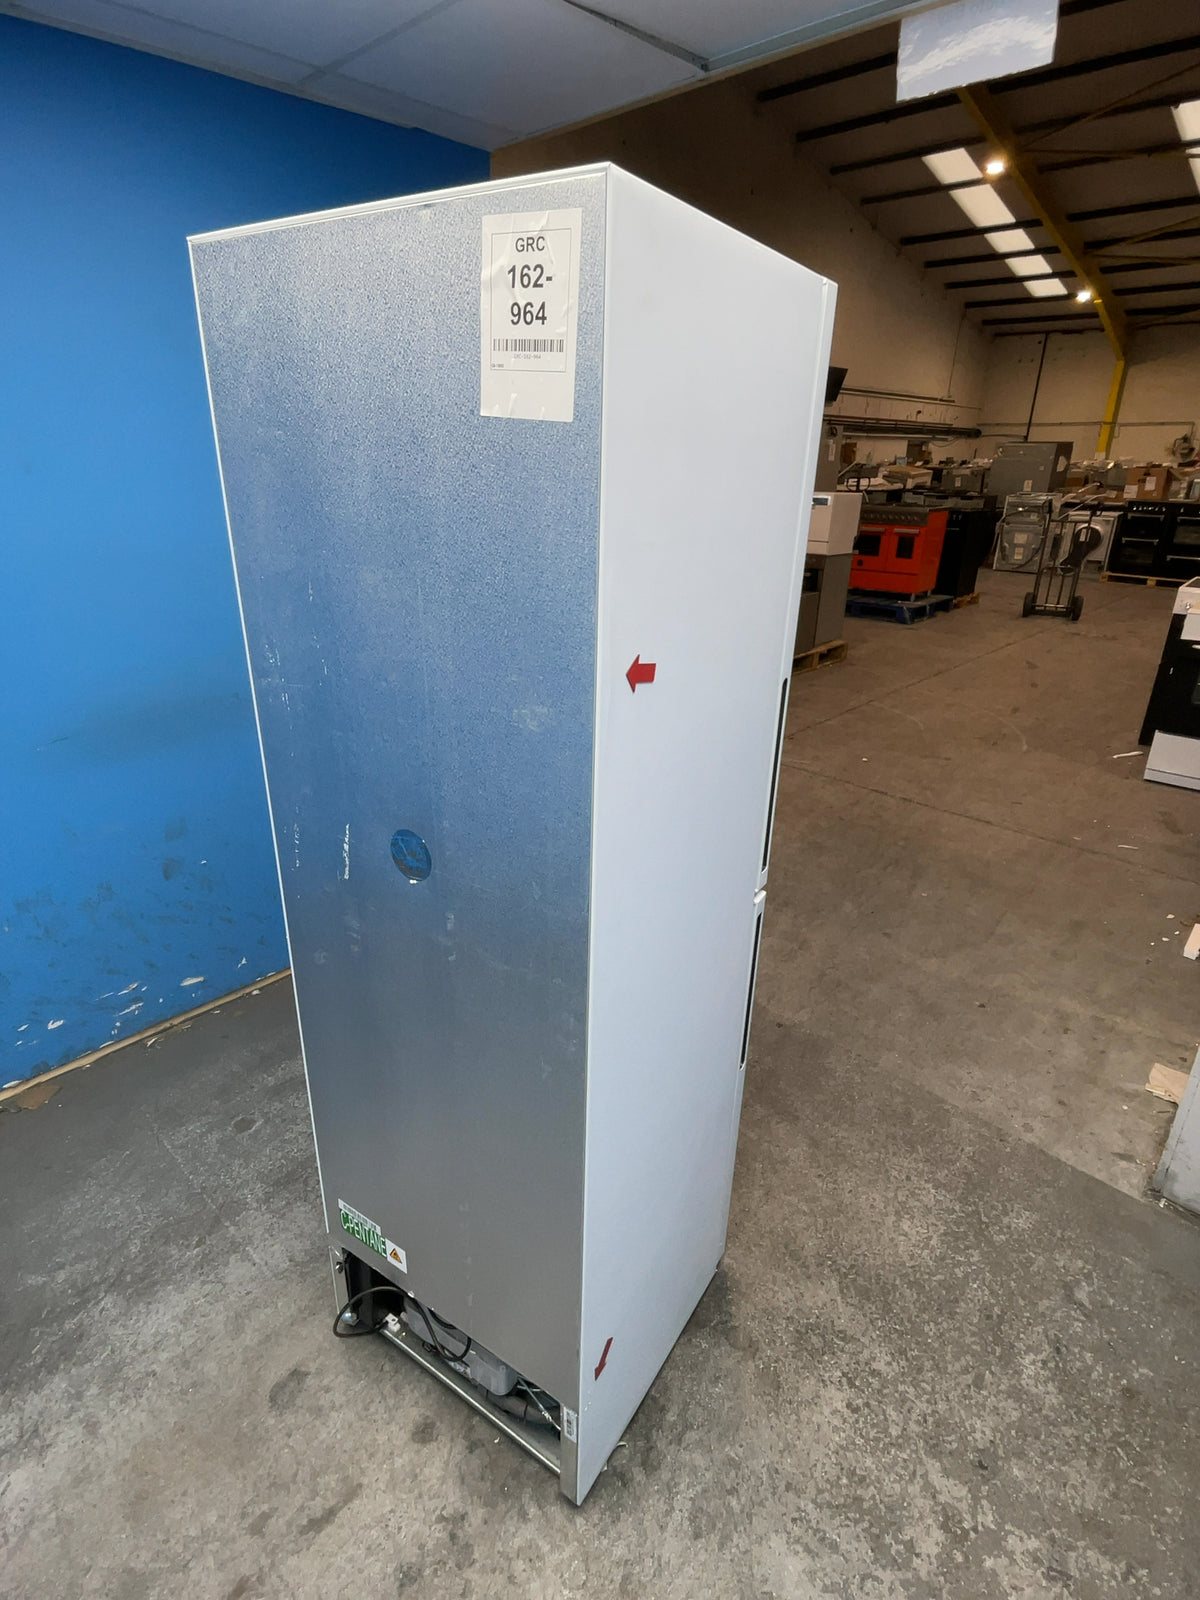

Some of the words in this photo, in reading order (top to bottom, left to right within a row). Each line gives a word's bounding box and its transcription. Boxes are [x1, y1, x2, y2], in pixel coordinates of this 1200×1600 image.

[515, 236, 546, 253] GRC
[507, 263, 553, 289] 162-
[510, 301, 547, 326] 964
